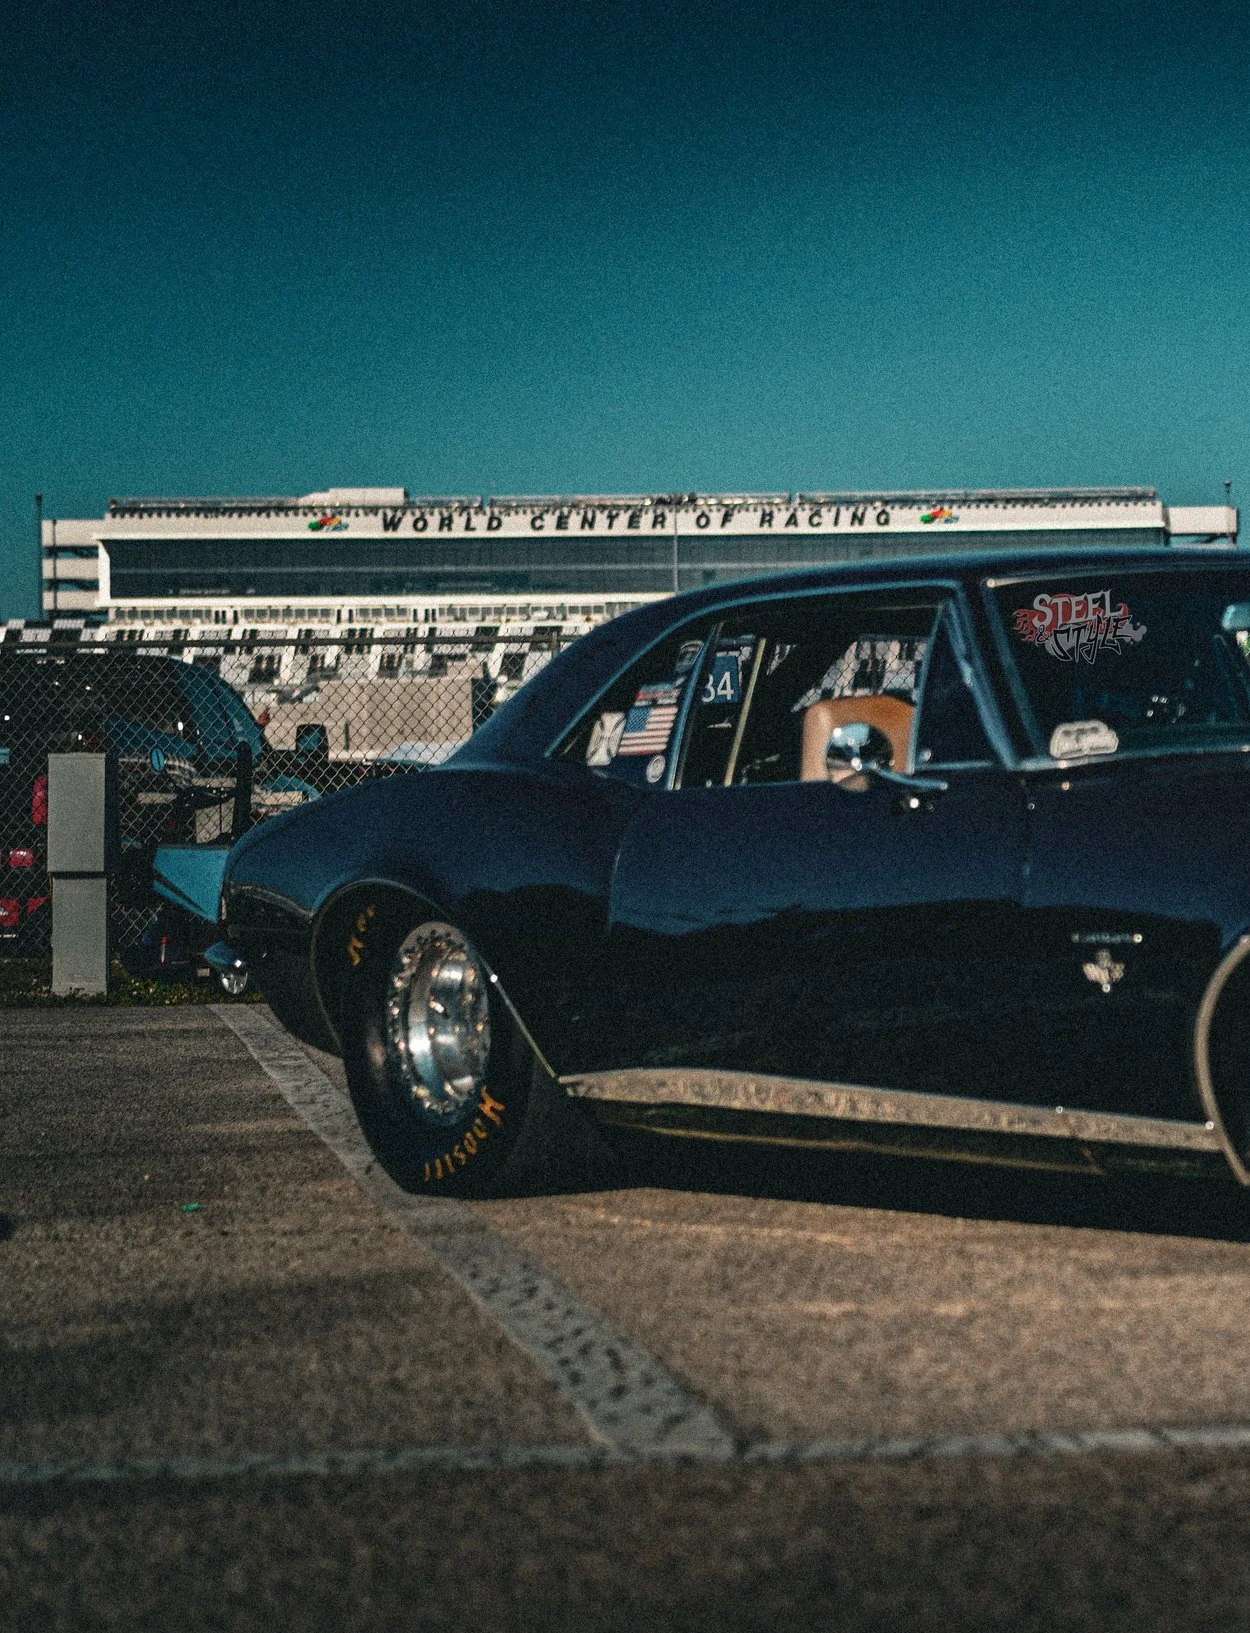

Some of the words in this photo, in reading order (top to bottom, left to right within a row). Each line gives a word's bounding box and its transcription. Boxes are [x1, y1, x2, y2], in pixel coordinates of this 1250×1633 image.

[381, 509, 503, 532] WORLD
[530, 508, 668, 531] CENTER
[694, 509, 735, 530] OF
[758, 506, 892, 529] RACING
